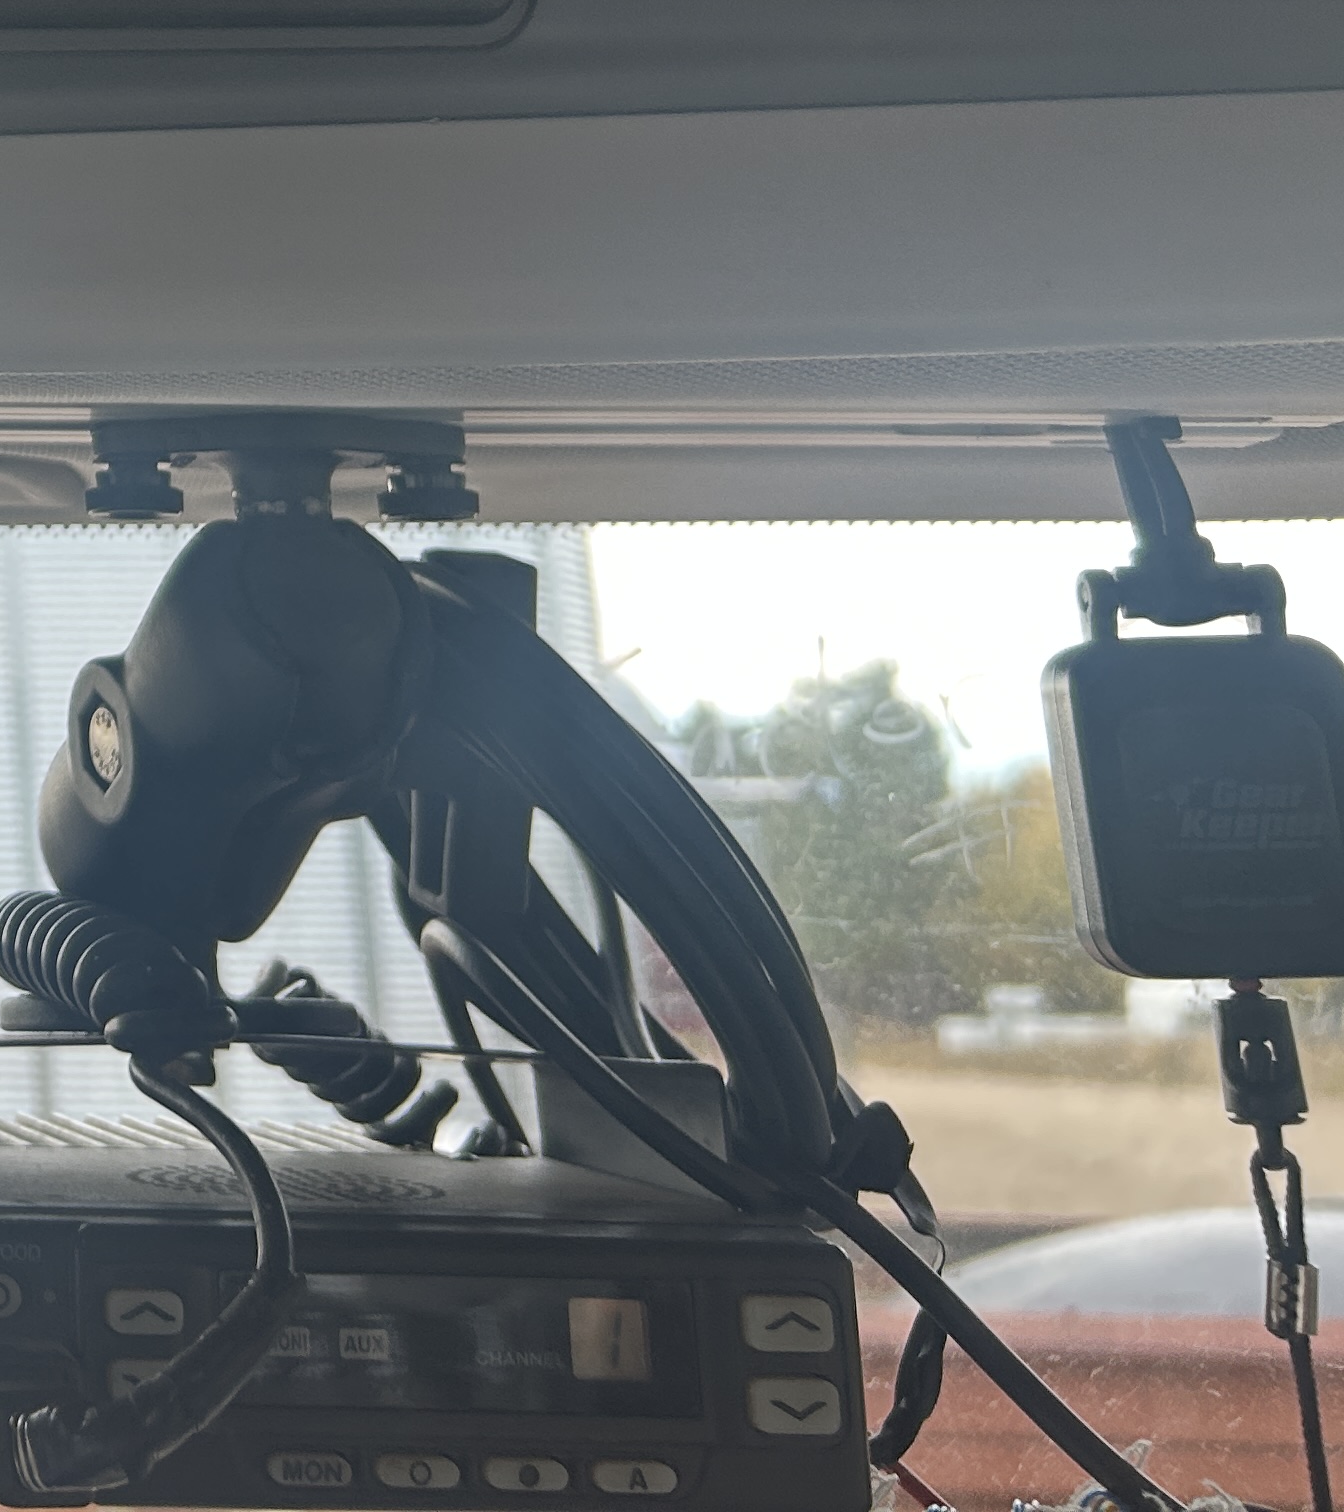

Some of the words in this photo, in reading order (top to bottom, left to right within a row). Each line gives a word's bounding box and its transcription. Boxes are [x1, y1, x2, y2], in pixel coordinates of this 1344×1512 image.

[344, 1333, 384, 1355] AUX
[475, 1350, 565, 1370] CHANNEL
[281, 1458, 342, 1483] MON
[629, 1467, 648, 1490] A
